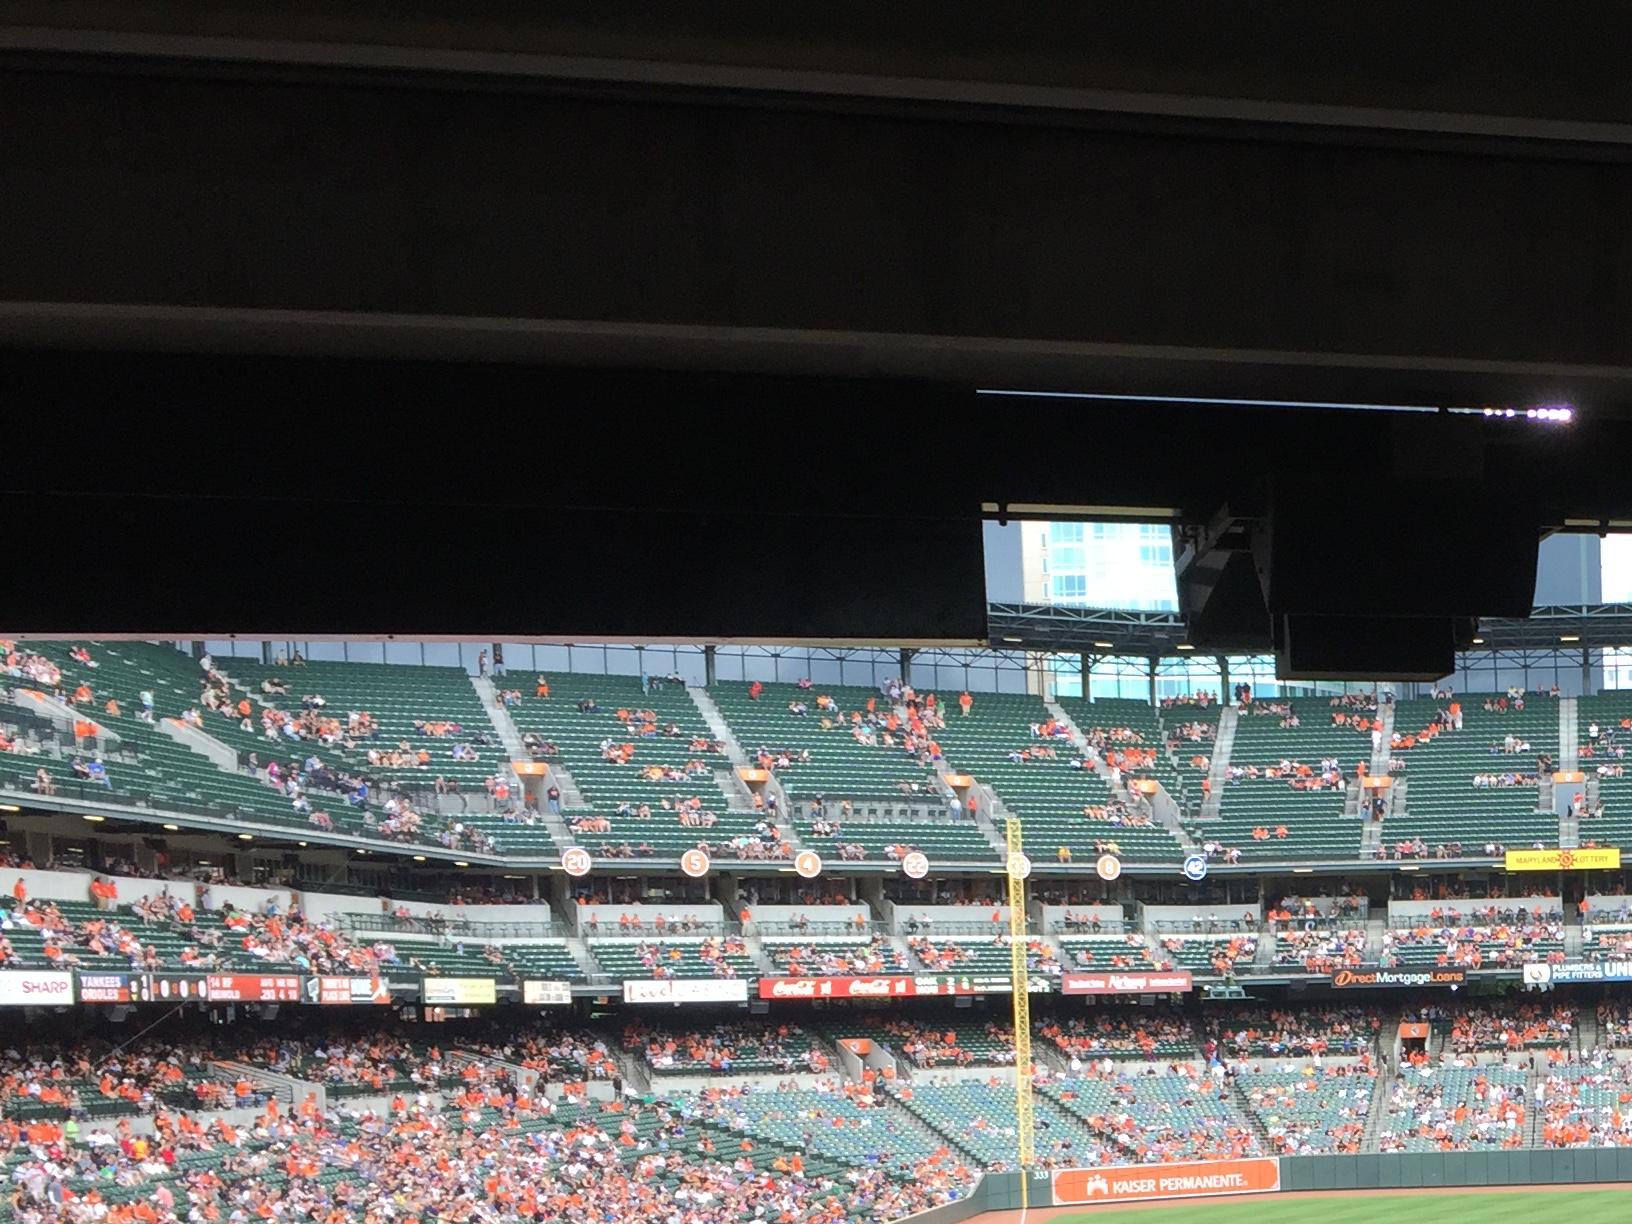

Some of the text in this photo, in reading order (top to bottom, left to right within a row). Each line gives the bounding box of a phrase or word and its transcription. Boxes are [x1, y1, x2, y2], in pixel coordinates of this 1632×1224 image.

[567, 855, 587, 869] 20
[690, 857, 700, 870] 5
[803, 857, 813, 870] 4
[1577, 855, 1608, 863] LOTTERY
[907, 860, 926, 873] 22
[1189, 861, 1203, 874] 42
[1335, 971, 1464, 986] DirectMortgageLoans
[1552, 970, 1603, 979] PIPE FITTERS
[22, 981, 68, 993] SHARP
[80, 976, 121, 988] YANKEES
[160, 979, 170, 997] 0
[179, 979, 189, 997] 0
[81, 988, 118, 1000] ORIOLES
[1033, 1171, 1049, 1179] 333
[1112, 1174, 1244, 1193] KAISER PERMANENTE
